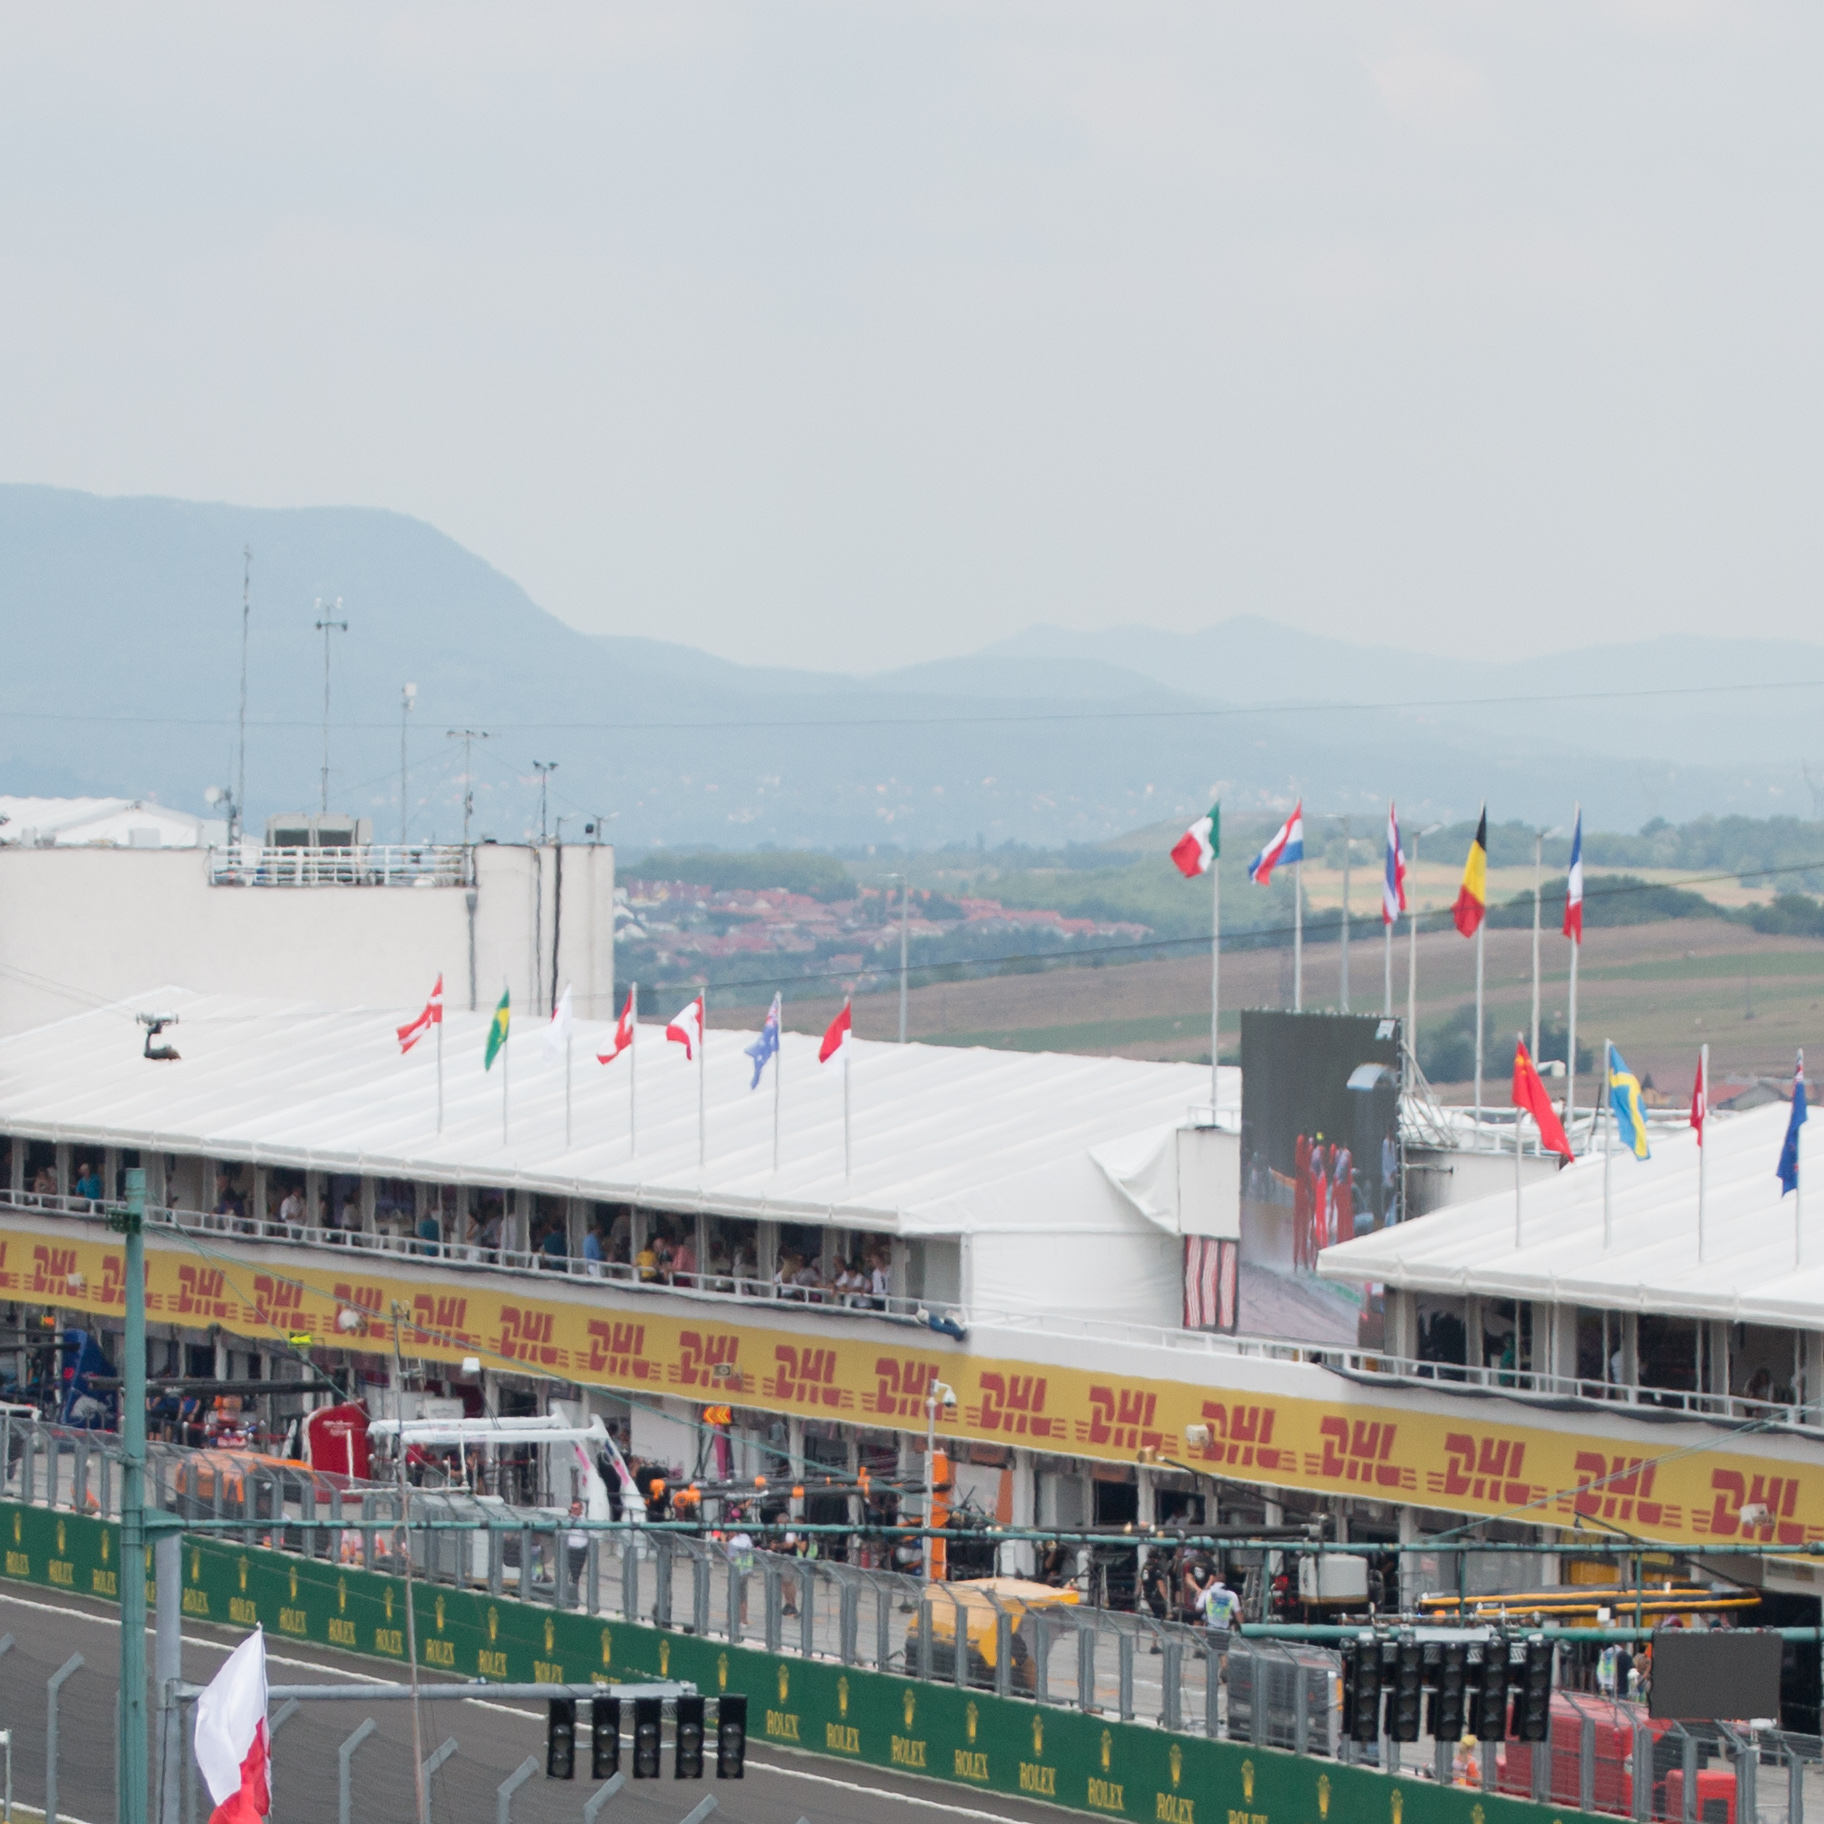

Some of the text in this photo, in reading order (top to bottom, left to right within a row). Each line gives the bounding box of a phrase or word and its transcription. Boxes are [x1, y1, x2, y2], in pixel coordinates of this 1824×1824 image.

[32, 1246, 83, 1298] DHL
[179, 1267, 229, 1318] DHL
[257, 1277, 308, 1330] DHL
[416, 1298, 466, 1346] DHL
[501, 1309, 559, 1367] DHL
[590, 1321, 651, 1380] DHL
[679, 1330, 740, 1393] DHL
[774, 1345, 842, 1408] DHL
[877, 1360, 944, 1423] DHL
[980, 1373, 1053, 1439] DHL
[1089, 1387, 1167, 1456] DHL
[1202, 1400, 1282, 1471] DHL
[1321, 1415, 1402, 1488] DHL
[1445, 1435, 1530, 1507] DHL
[1576, 1453, 1662, 1528] DHL
[1711, 1469, 1805, 1544] DHL
[183, 1588, 209, 1614] ROLEX
[229, 1597, 256, 1624] ROLEX
[279, 1607, 306, 1633] ROLEX
[328, 1618, 356, 1645] ROLEX
[375, 1628, 403, 1654] ROLEX
[425, 1639, 455, 1666] ROLEX
[478, 1649, 507, 1677] ROLEX
[766, 1709, 799, 1740] ROLEX
[826, 1722, 860, 1753] ROLEX
[891, 1735, 926, 1767] ROLEX
[954, 1749, 989, 1780] ROLEX
[1019, 1762, 1056, 1796] ROLEX
[1087, 1777, 1124, 1811] ROLEX
